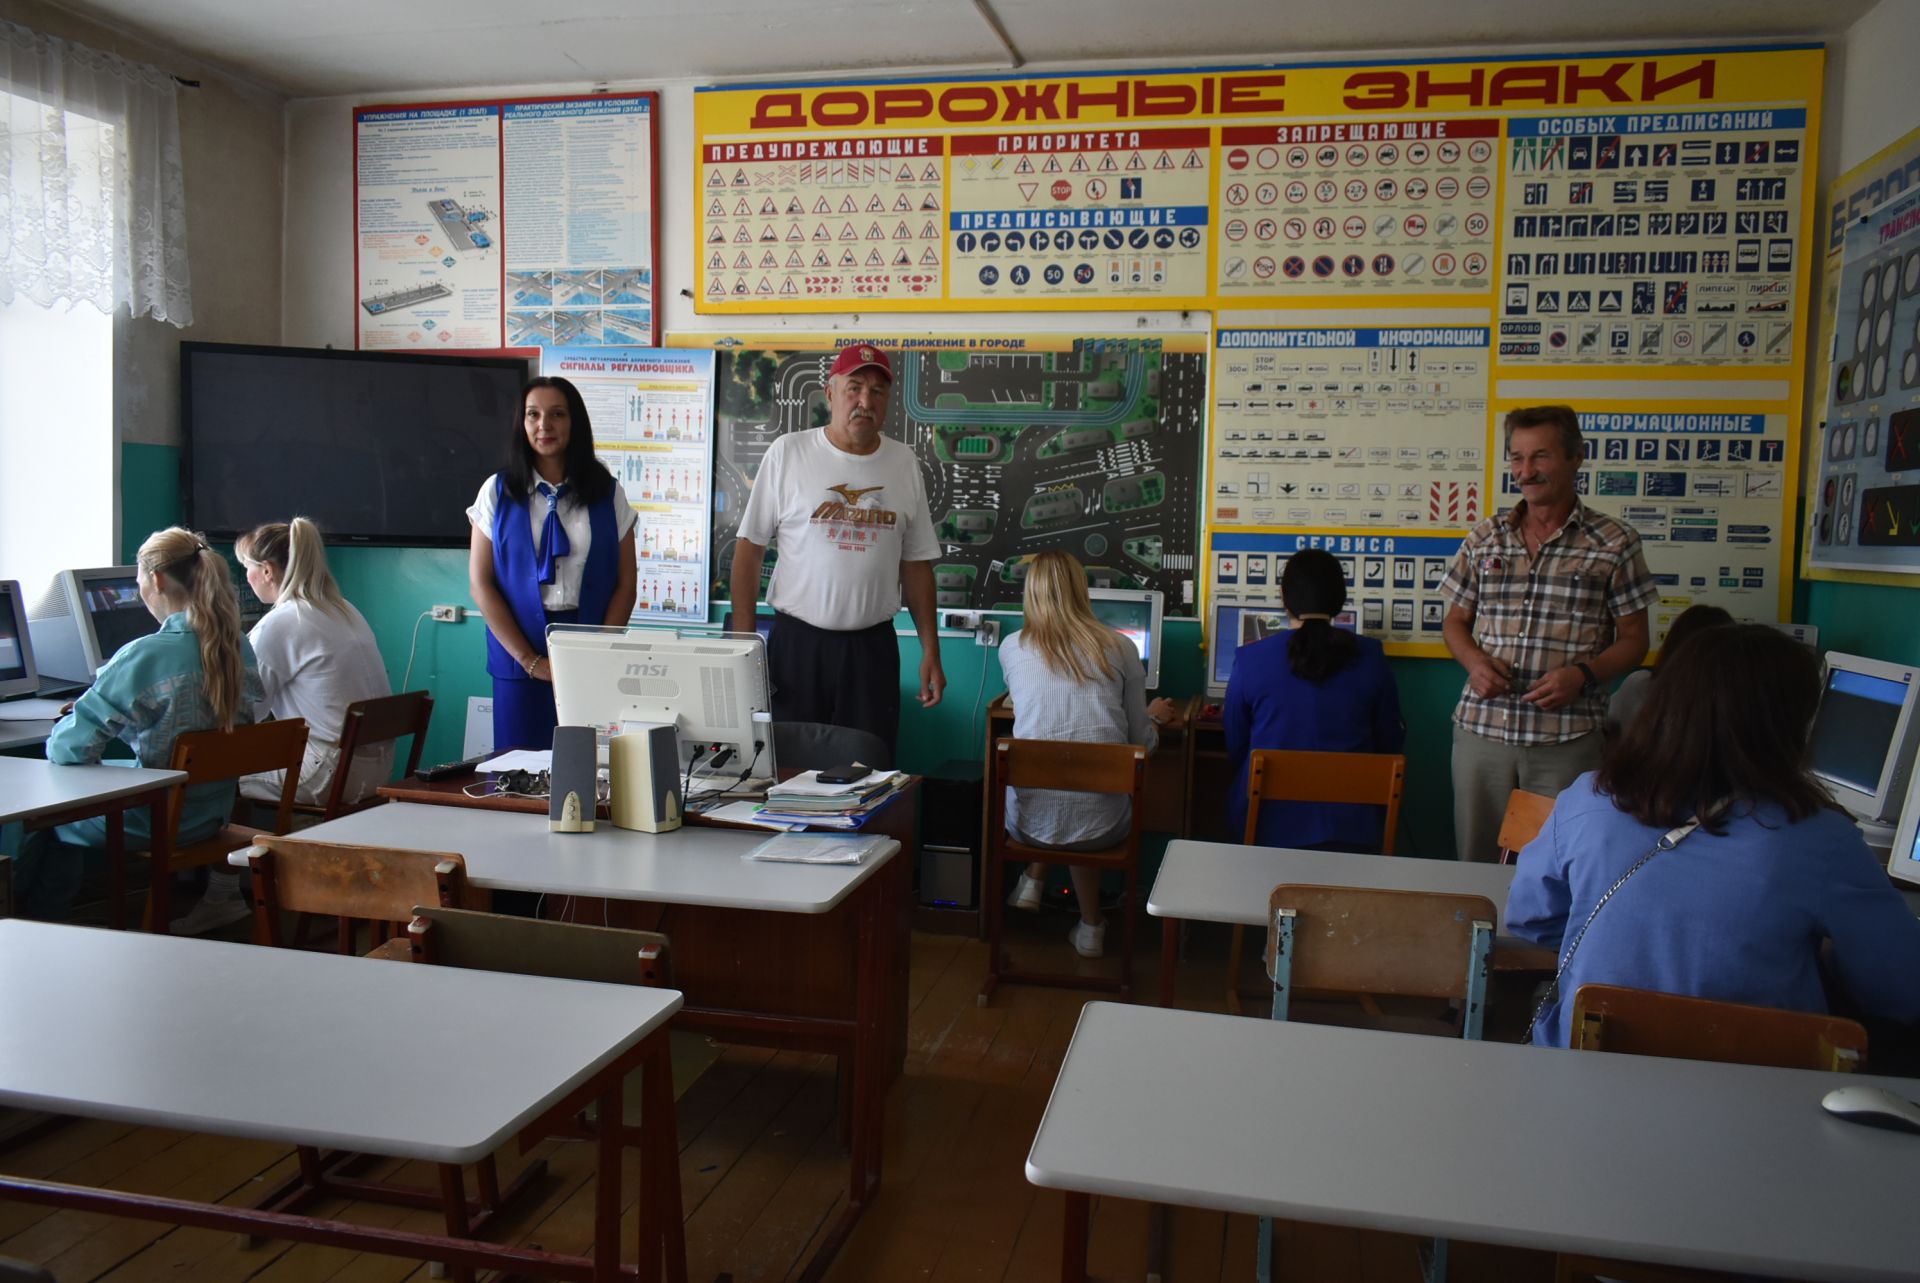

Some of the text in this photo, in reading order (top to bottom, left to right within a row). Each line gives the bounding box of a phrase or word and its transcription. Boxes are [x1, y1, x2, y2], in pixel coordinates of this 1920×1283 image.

[750, 60, 1716, 128] ДОРОЖНЫЕ ЗНАКИ
[1538, 110, 1773, 134] ОСОБЫХ ПРЕДПИСАНИЙ
[1277, 122, 1446, 143] ЗАПРЕЩАЮЩИЕ
[712, 138, 928, 161] ПРЕДУПРЕЖДАЮЩИЕ
[998, 132, 1140, 152] ПРИОРИТЕТА
[1051, 185, 1072, 195] STOP
[961, 209, 1176, 229] ПРЕДПИСЫВАЮЩИЕ
[1470, 219, 1484, 230] 50
[1047, 270, 1061, 280] 50
[1699, 284, 1736, 293] ЛИПЕЦК
[1502, 324, 1540, 333] ОРЛОВО
[835, 338, 1026, 349] ДОРОЖНОЕ ДВИЖЕНИЕ В ГОРОДЕ
[1220, 329, 1484, 347] ДОПОЛНИТЕЛЬНОЙ ИНФОРМАЦИИ
[560, 361, 695, 375] СИГНАЛЫ РЕГУЛИРОВЩИКА
[1296, 536, 1395, 553] СЕРВИСА
[625, 663, 669, 677] msi
